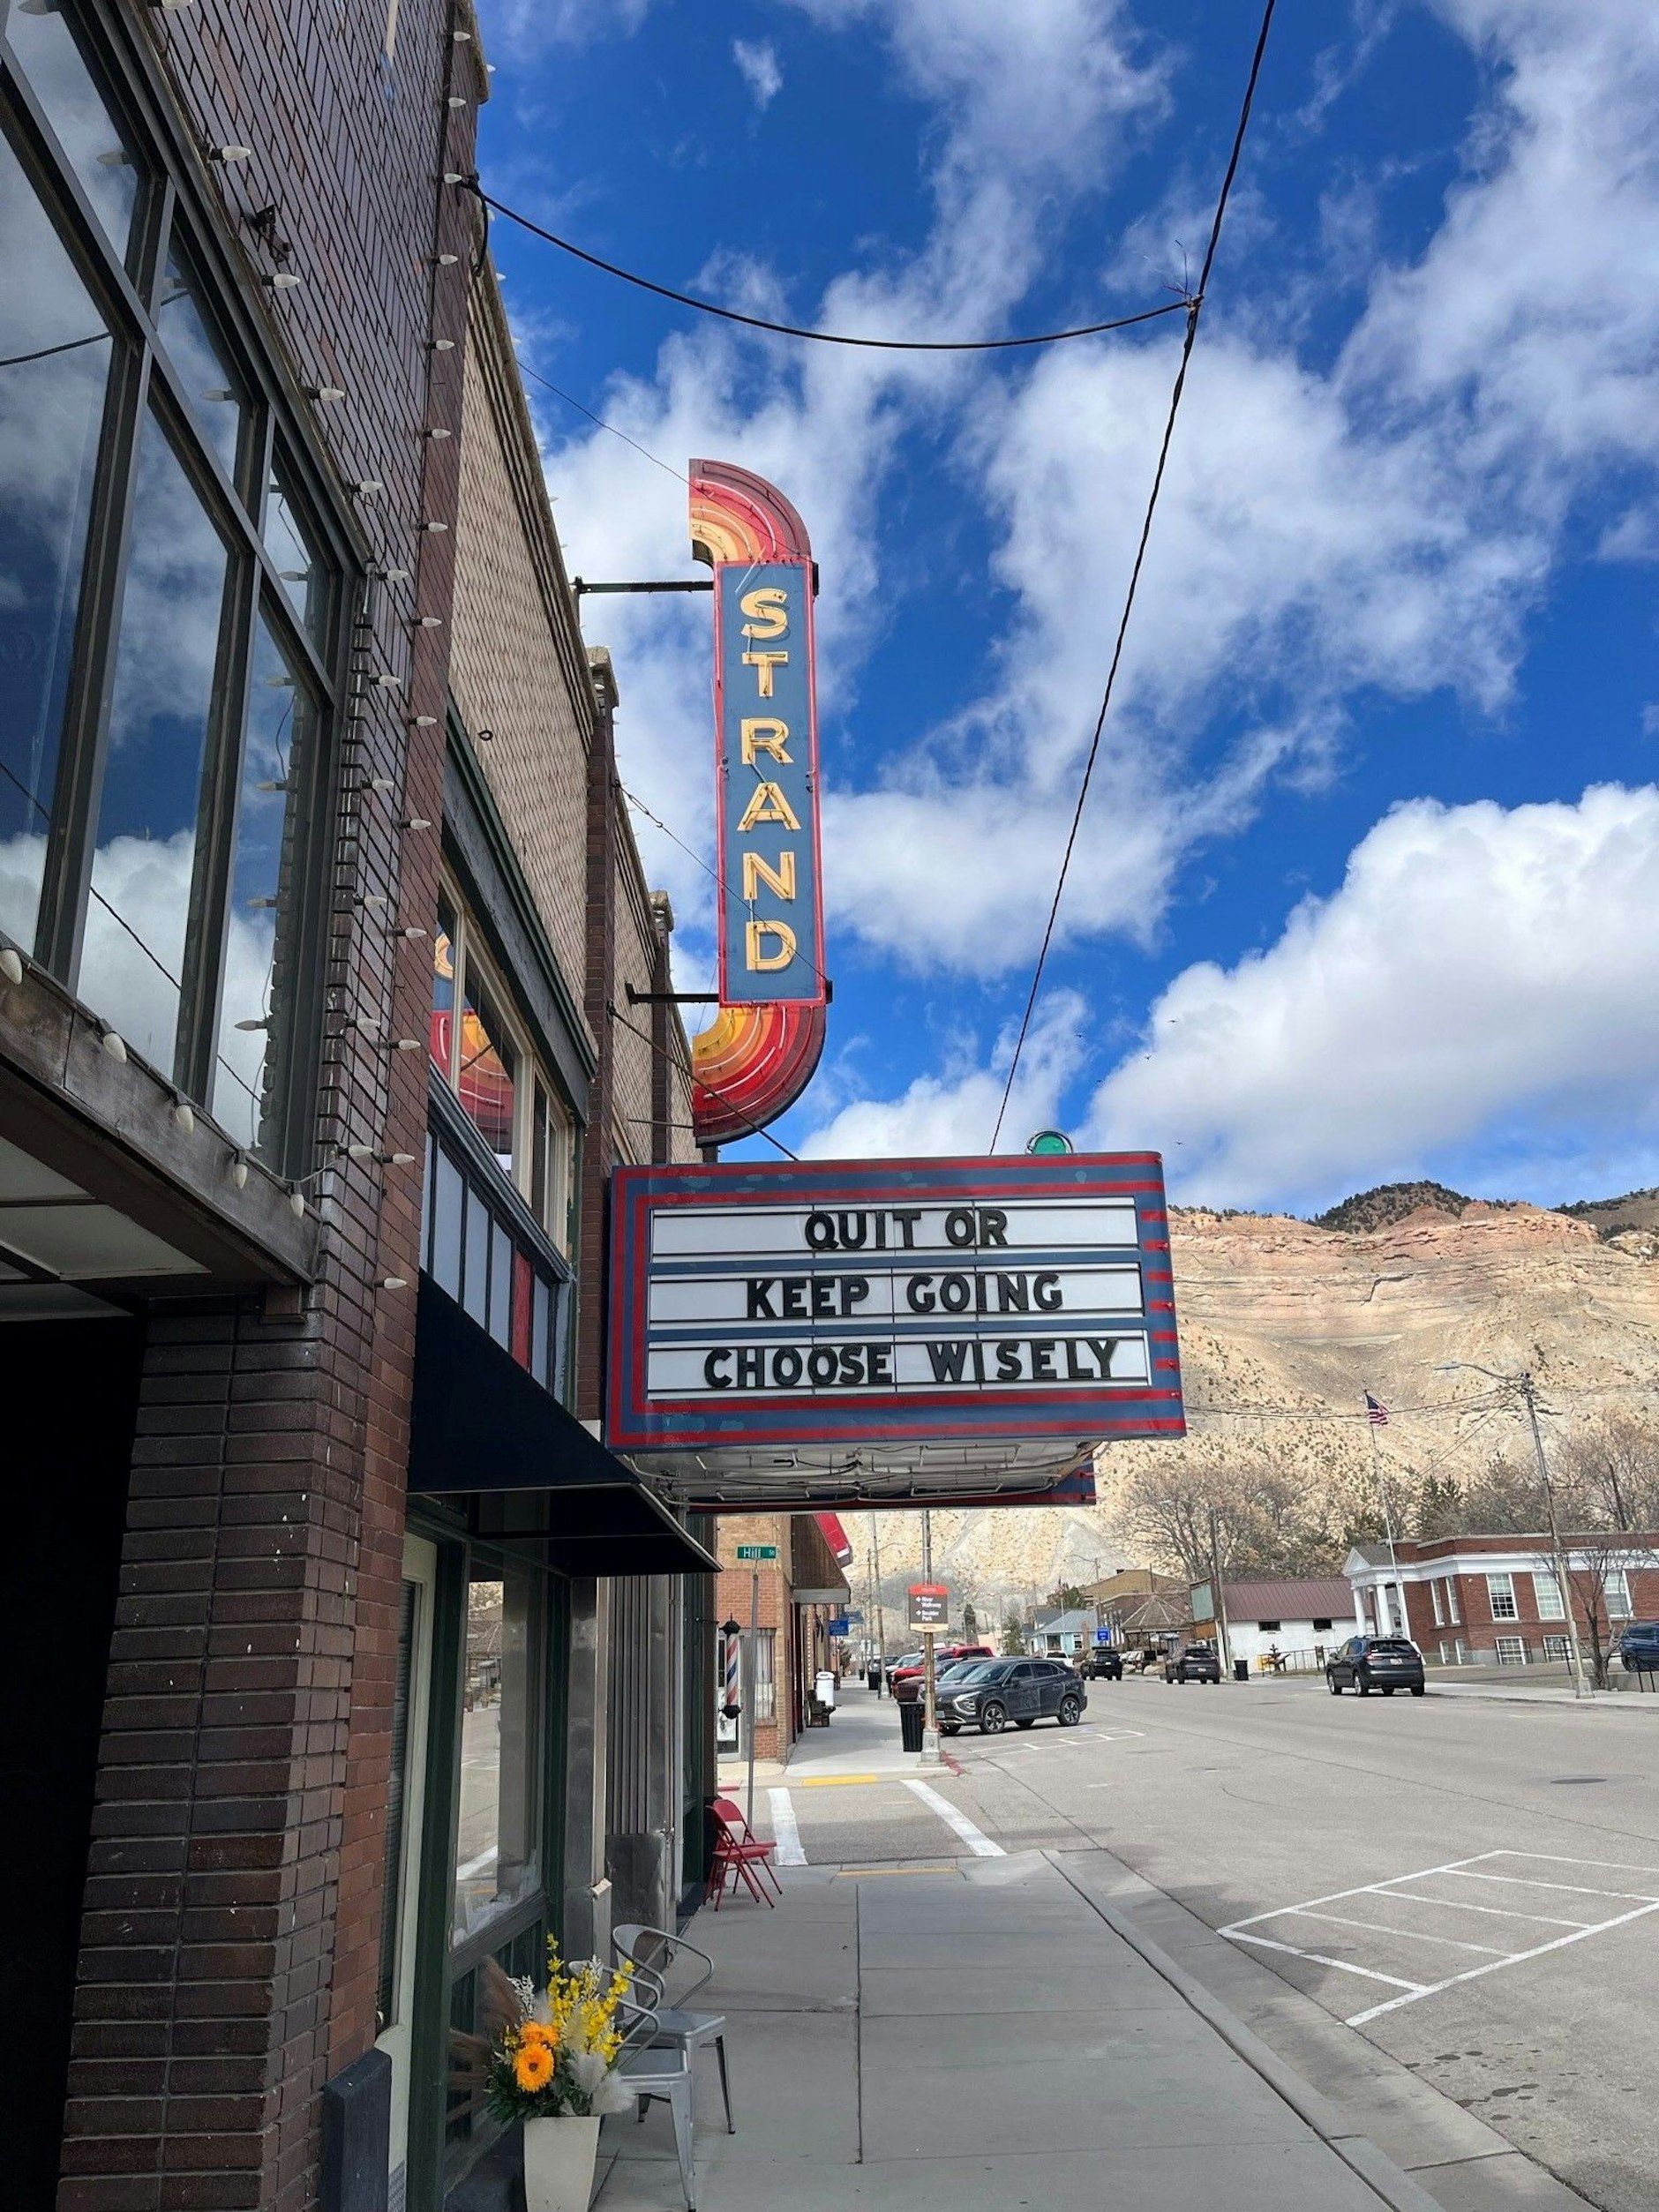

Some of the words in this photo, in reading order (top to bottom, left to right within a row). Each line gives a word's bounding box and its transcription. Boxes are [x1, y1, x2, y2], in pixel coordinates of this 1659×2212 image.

[737, 588, 801, 971] STRAND
[804, 1209, 922, 1250] QUIT
[944, 1208, 1009, 1248] OR
[747, 1277, 870, 1319] KEEP
[906, 1271, 1062, 1313] GOING
[703, 1342, 893, 1389] CHOOSE
[926, 1337, 1119, 1383] WISELY
[743, 1547, 762, 1558] Hill
